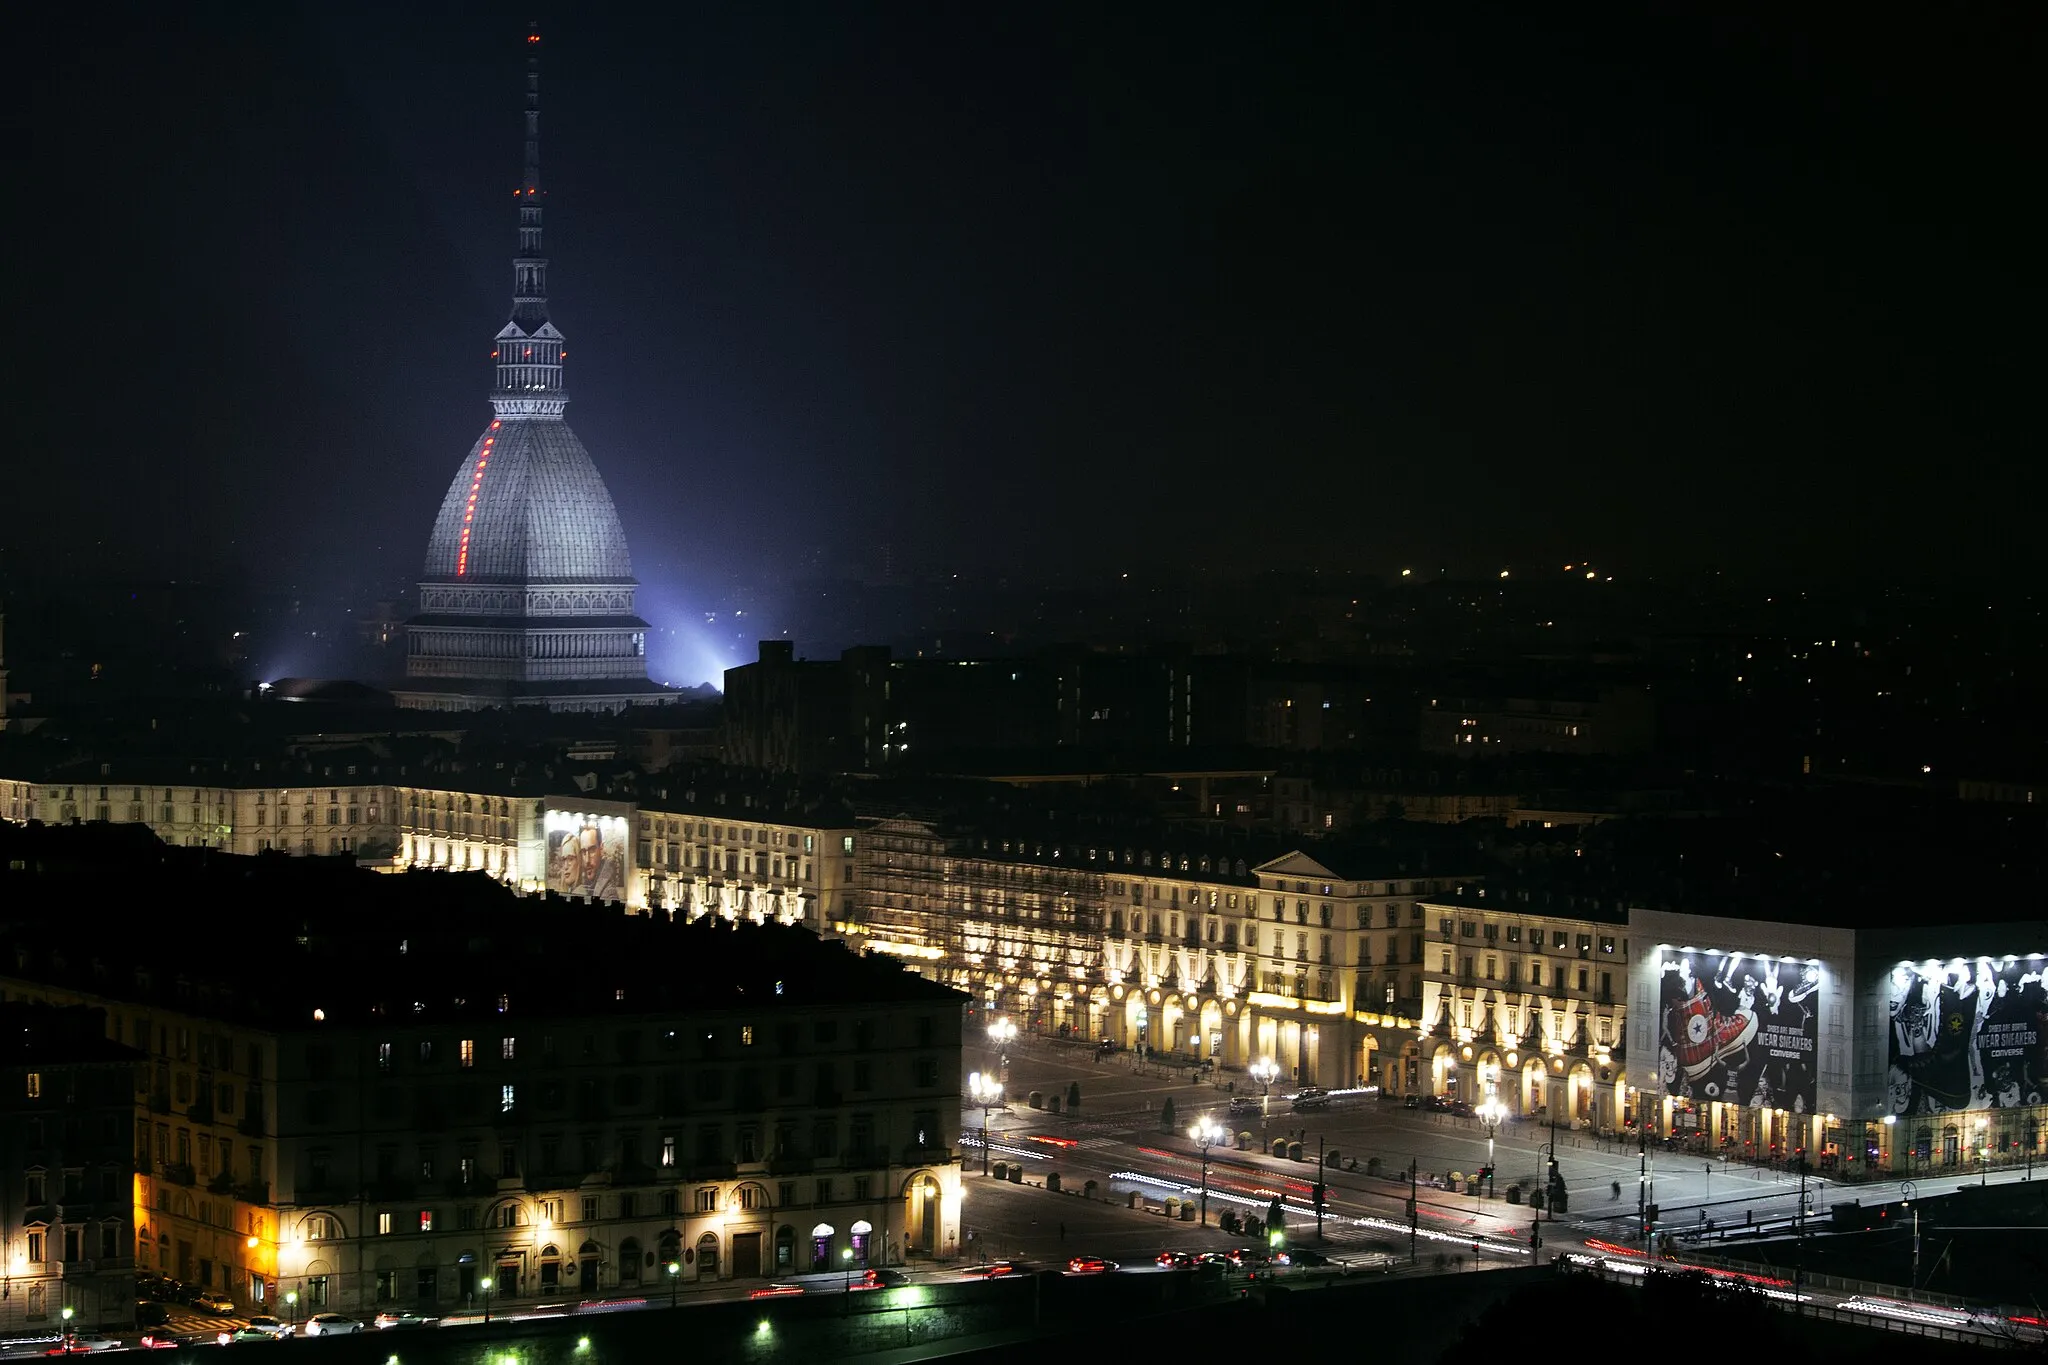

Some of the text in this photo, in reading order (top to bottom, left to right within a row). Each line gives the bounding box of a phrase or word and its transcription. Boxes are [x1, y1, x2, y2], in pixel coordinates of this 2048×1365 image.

[1758, 1032, 1812, 1051] WEAR SNEAKERS
[1978, 1032, 2036, 1048] WEAR SNEAKERS
[1770, 1049, 1800, 1059] CONVERSE
[1991, 1048, 2024, 1057] CONVERSE
